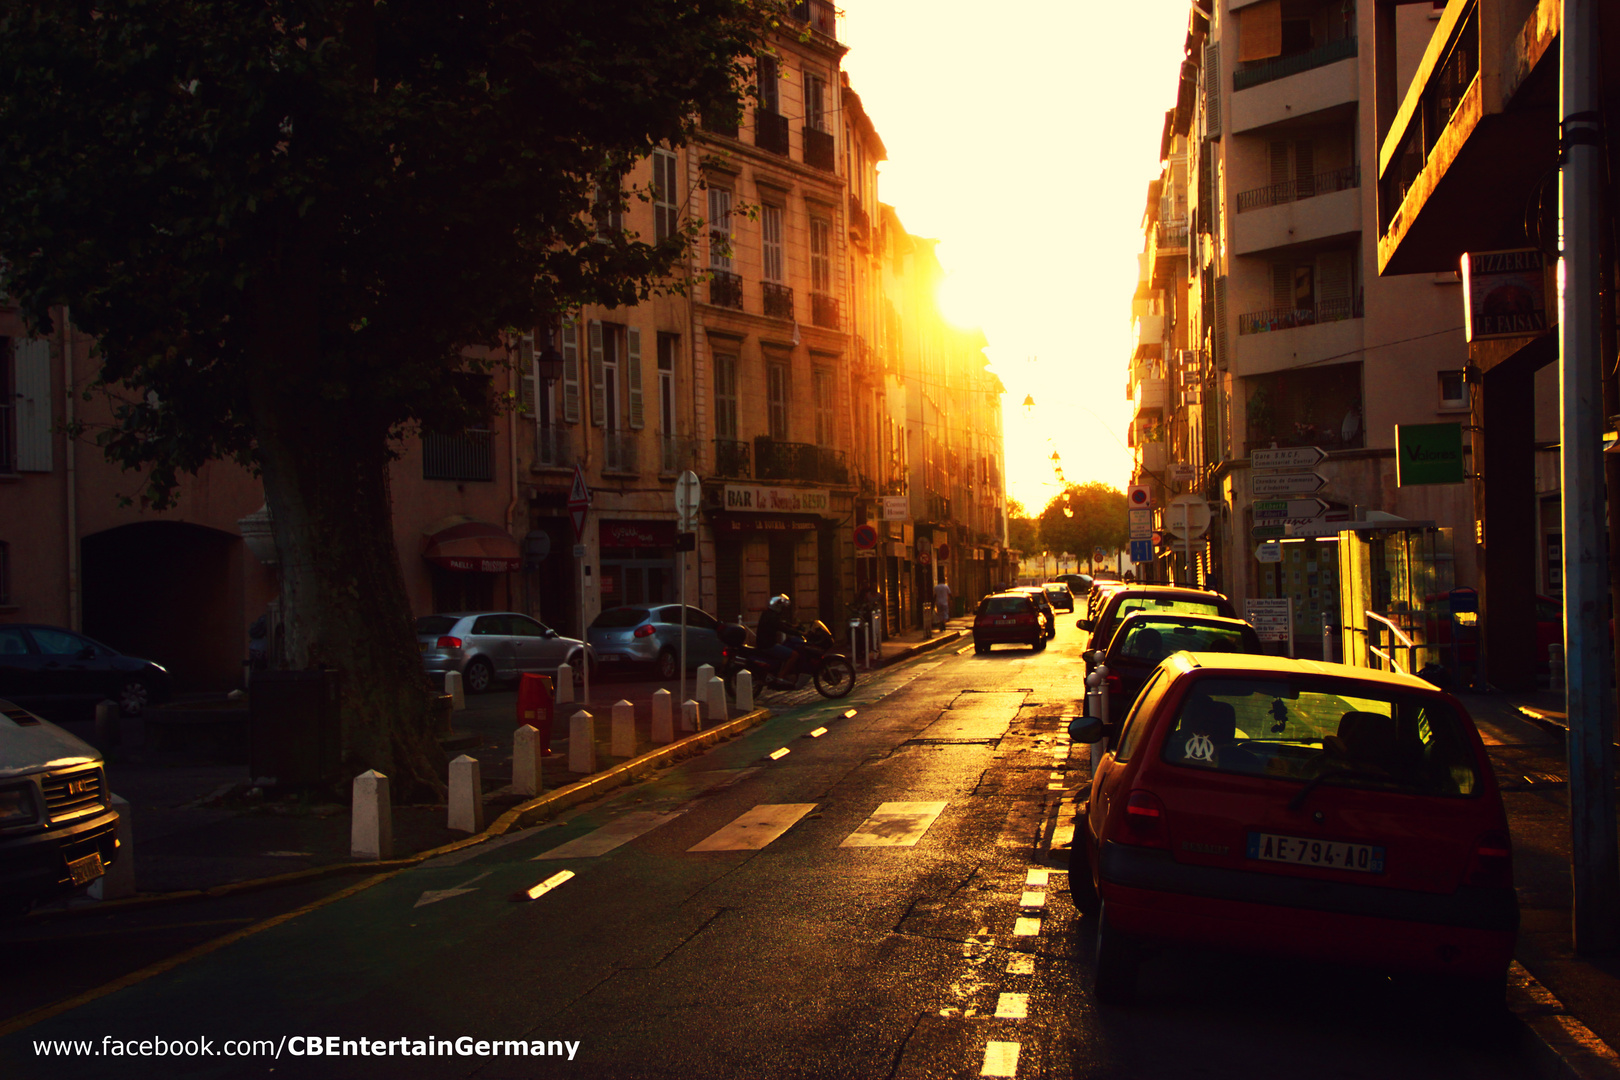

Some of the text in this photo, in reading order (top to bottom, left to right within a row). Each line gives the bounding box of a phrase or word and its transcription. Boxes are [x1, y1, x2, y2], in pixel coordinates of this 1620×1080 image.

[1472, 252, 1542, 273] PIZZERIA
[1476, 317, 1493, 334] LE
[1406, 445, 1457, 461] Valores
[727, 490, 752, 507] BAR
[802, 494, 826, 509] RESTO
[1370, 860, 1384, 871] 83
